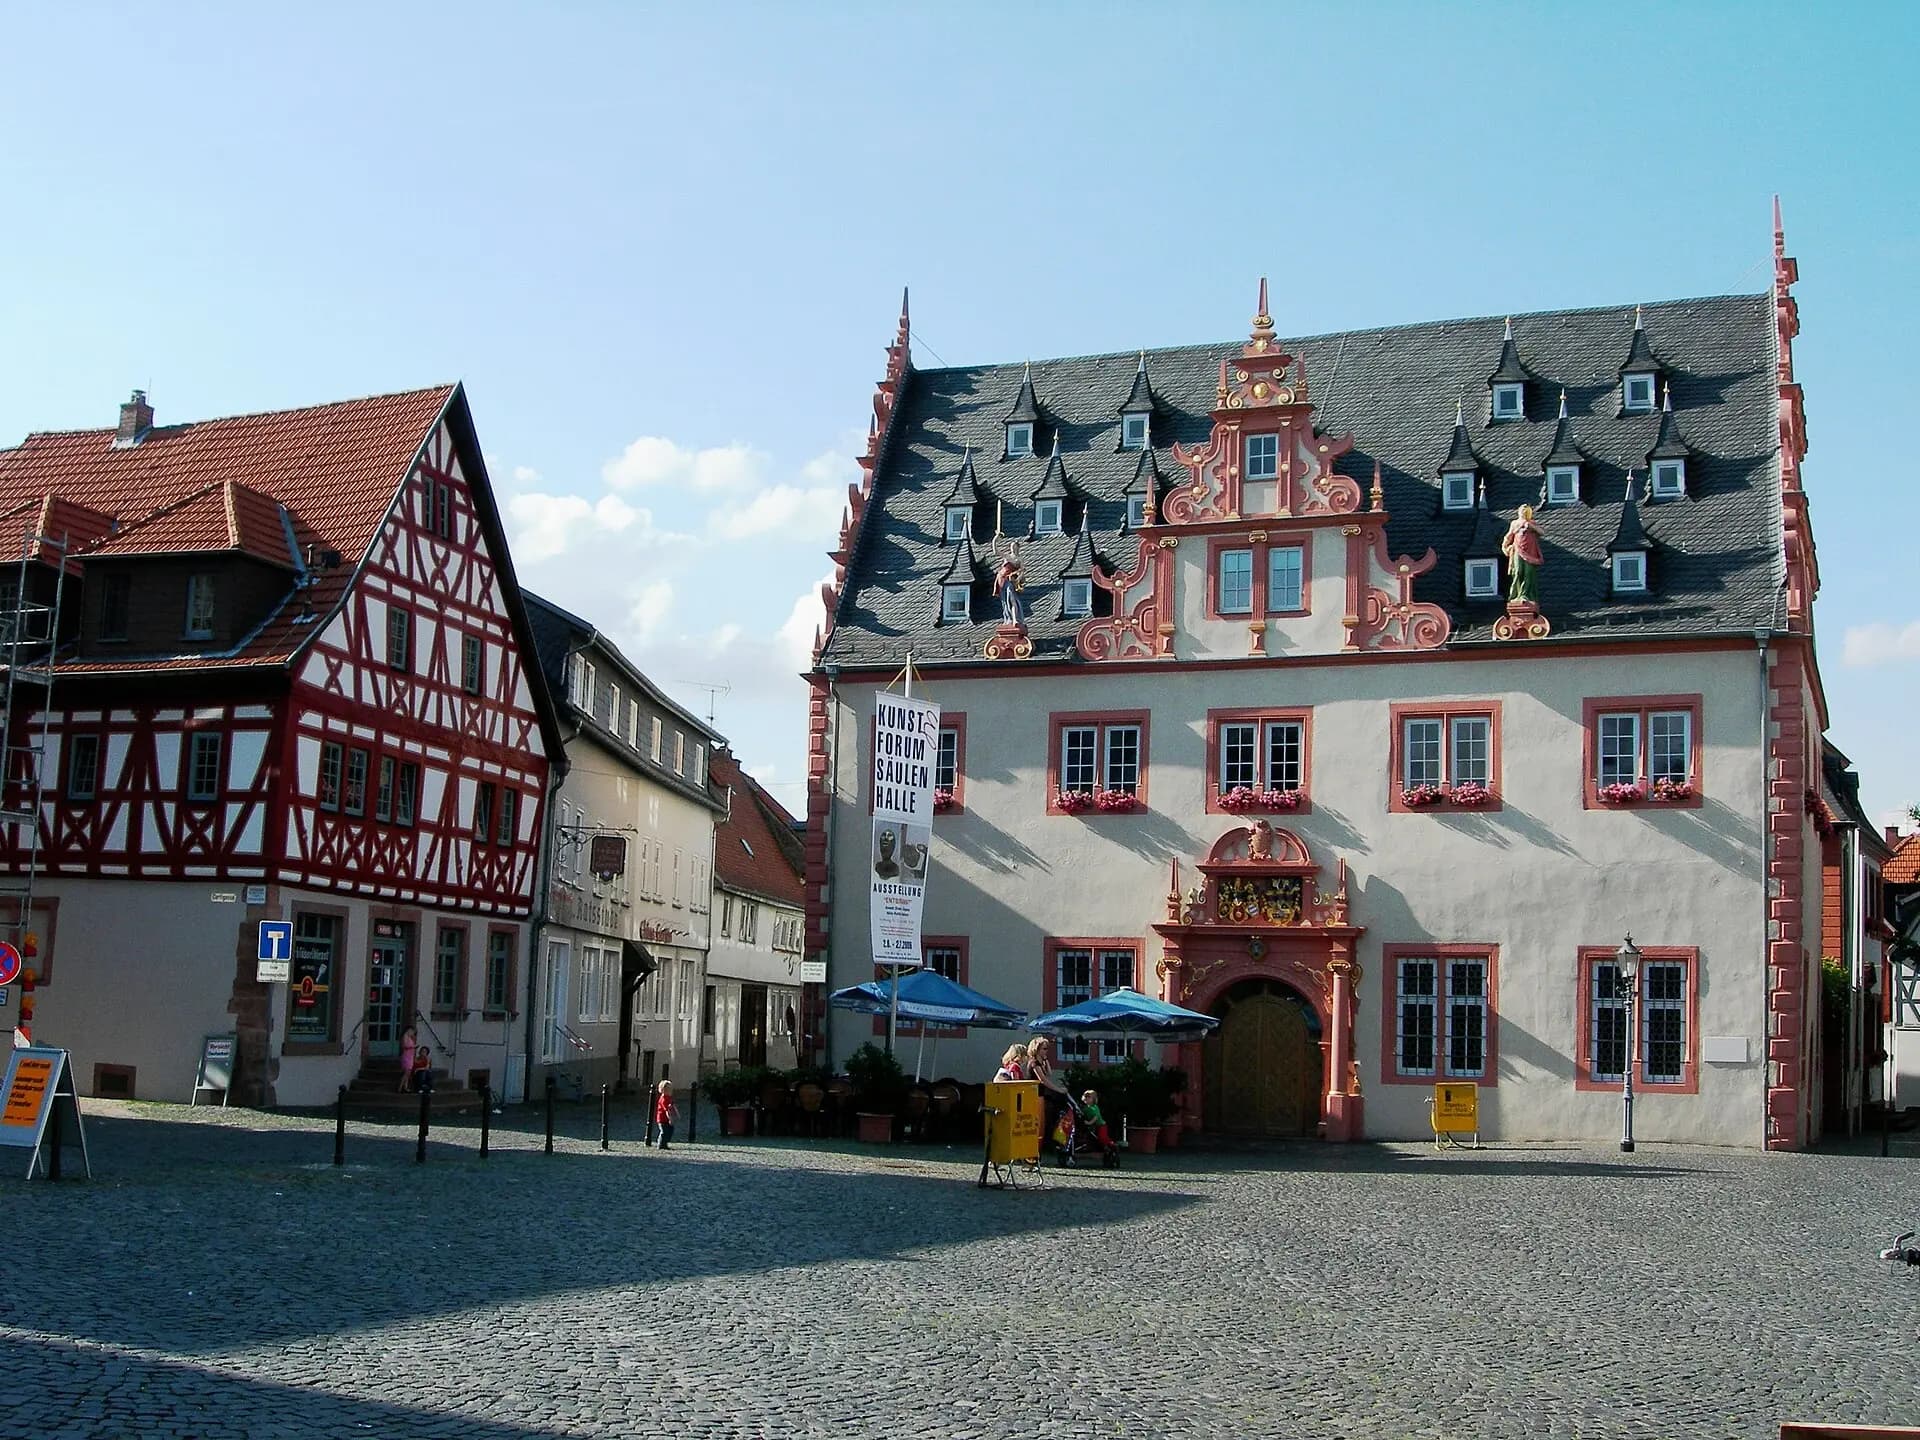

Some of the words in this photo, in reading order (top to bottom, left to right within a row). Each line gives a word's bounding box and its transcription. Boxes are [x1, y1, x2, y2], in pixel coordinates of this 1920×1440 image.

[878, 704, 924, 734] KUNST
[877, 731, 925, 761] FORUM
[876, 756, 929, 789] SÄULEN
[876, 785, 916, 814] HALLE
[873, 883, 922, 898] AUSSTELLUNG
